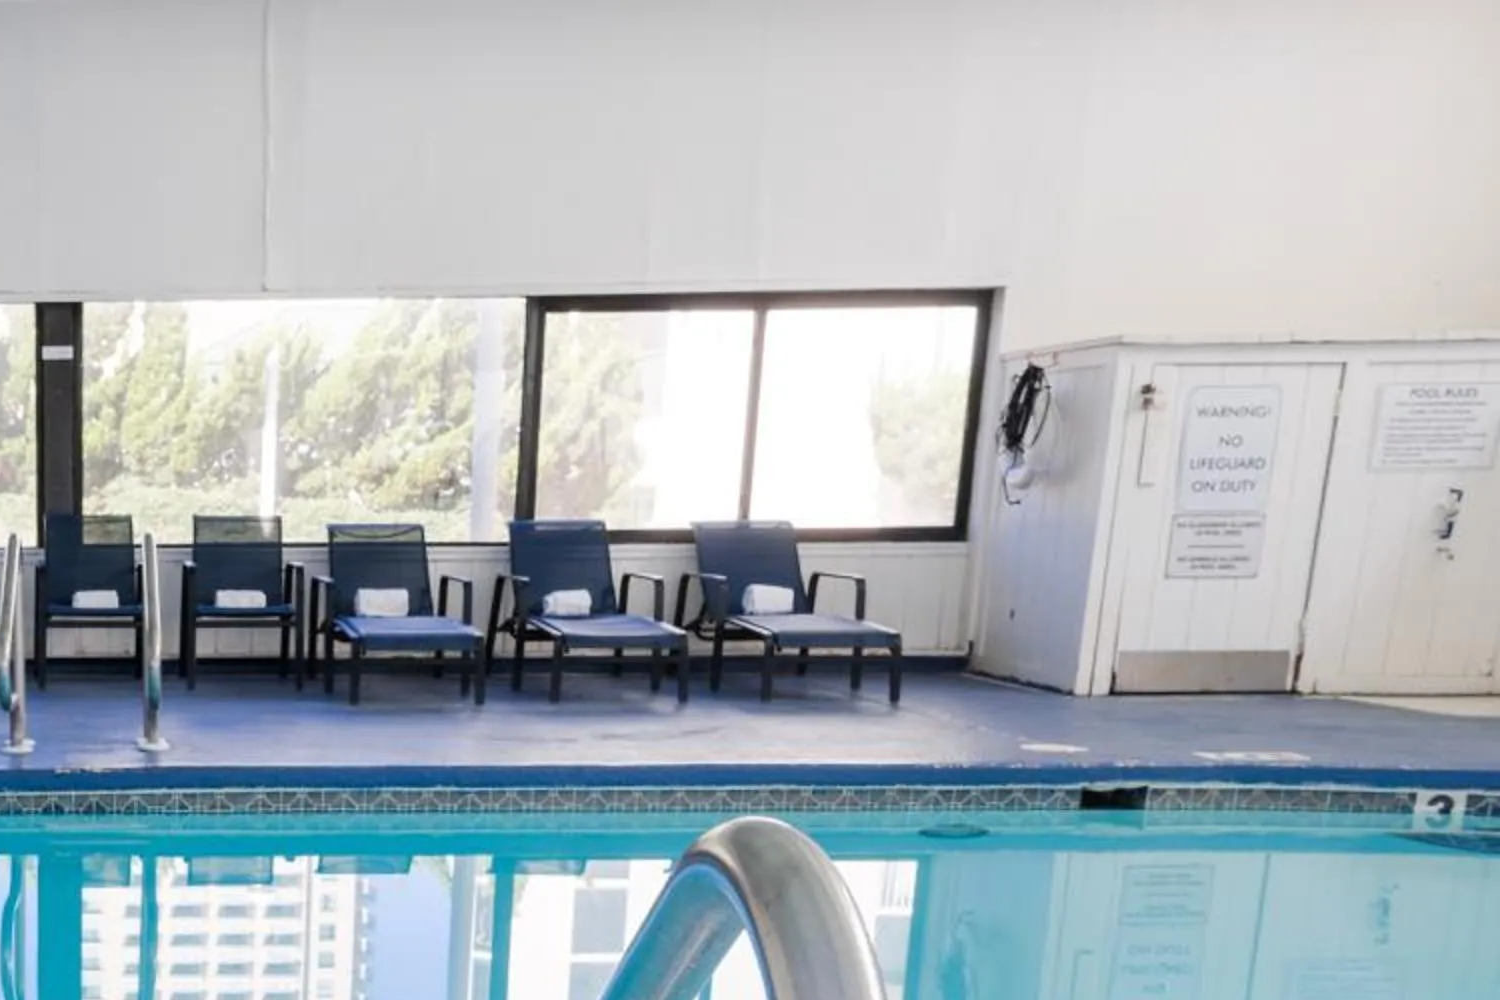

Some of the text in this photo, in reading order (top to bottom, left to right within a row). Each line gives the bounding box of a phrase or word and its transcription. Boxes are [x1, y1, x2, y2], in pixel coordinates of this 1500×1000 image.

[1218, 433, 1244, 448] NO
[1189, 456, 1267, 471] LIFEGUARD
[1191, 479, 1257, 494] ON DUTY
[1425, 793, 1454, 829] 3
